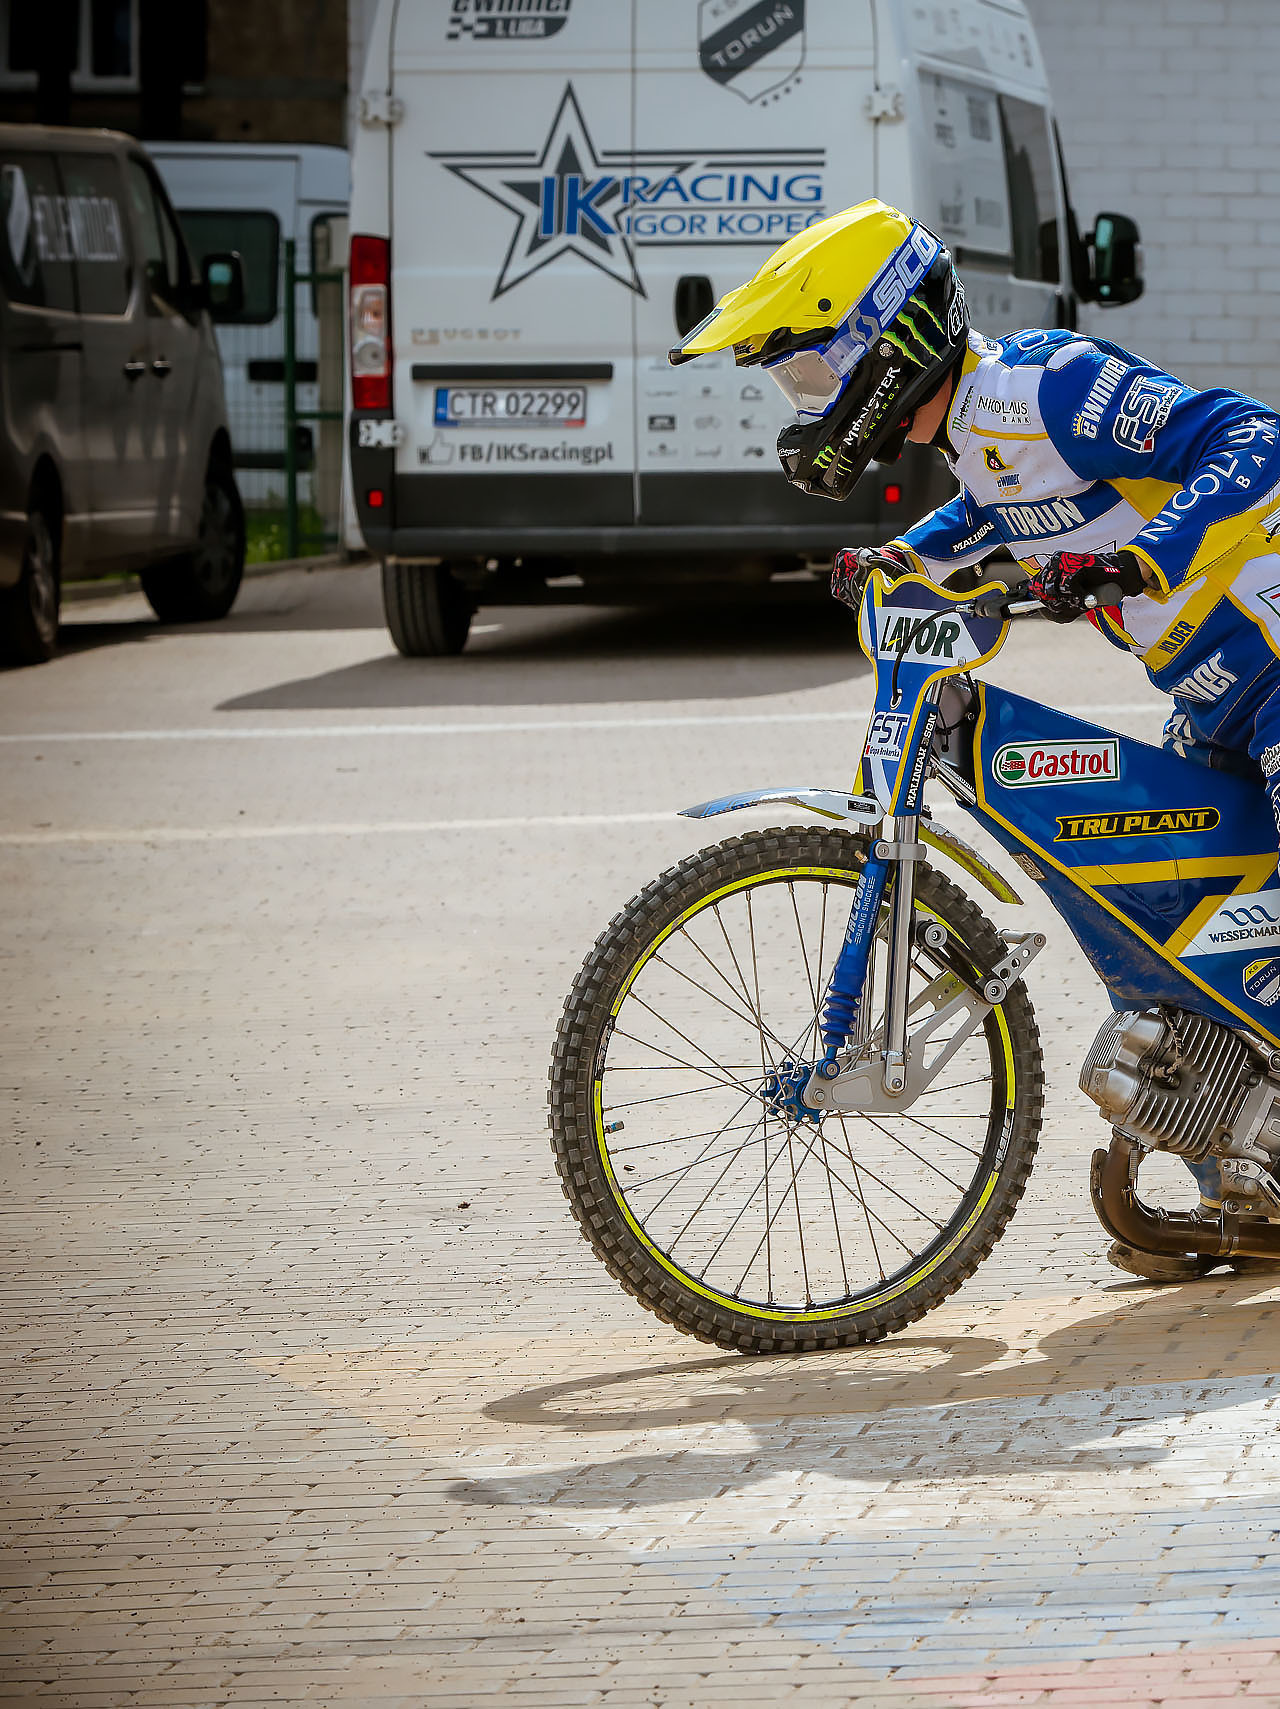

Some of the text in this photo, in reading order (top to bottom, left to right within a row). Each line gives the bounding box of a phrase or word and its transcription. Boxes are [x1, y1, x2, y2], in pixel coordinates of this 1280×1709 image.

[710, 2, 794, 67] TORUŃ
[539, 173, 824, 236] IK RACING
[625, 214, 707, 236] IGOR
[450, 391, 582, 416] CTR 02299
[863, 383, 901, 440] ENERGY
[977, 395, 1028, 415] NICOLAUS
[1002, 415, 1030, 424] BANK
[1113, 375, 1167, 453] FST
[458, 441, 614, 464] FB/IKSracingpl
[1235, 416, 1279, 490] BANK
[1140, 414, 1259, 541] NICOLAUS
[869, 714, 909, 747] FST
[1029, 748, 1111, 779] Castrol
[1067, 811, 1209, 837] TRU PLANT
[846, 873, 867, 944] FALCON
[862, 884, 874, 911] SHOCKS
